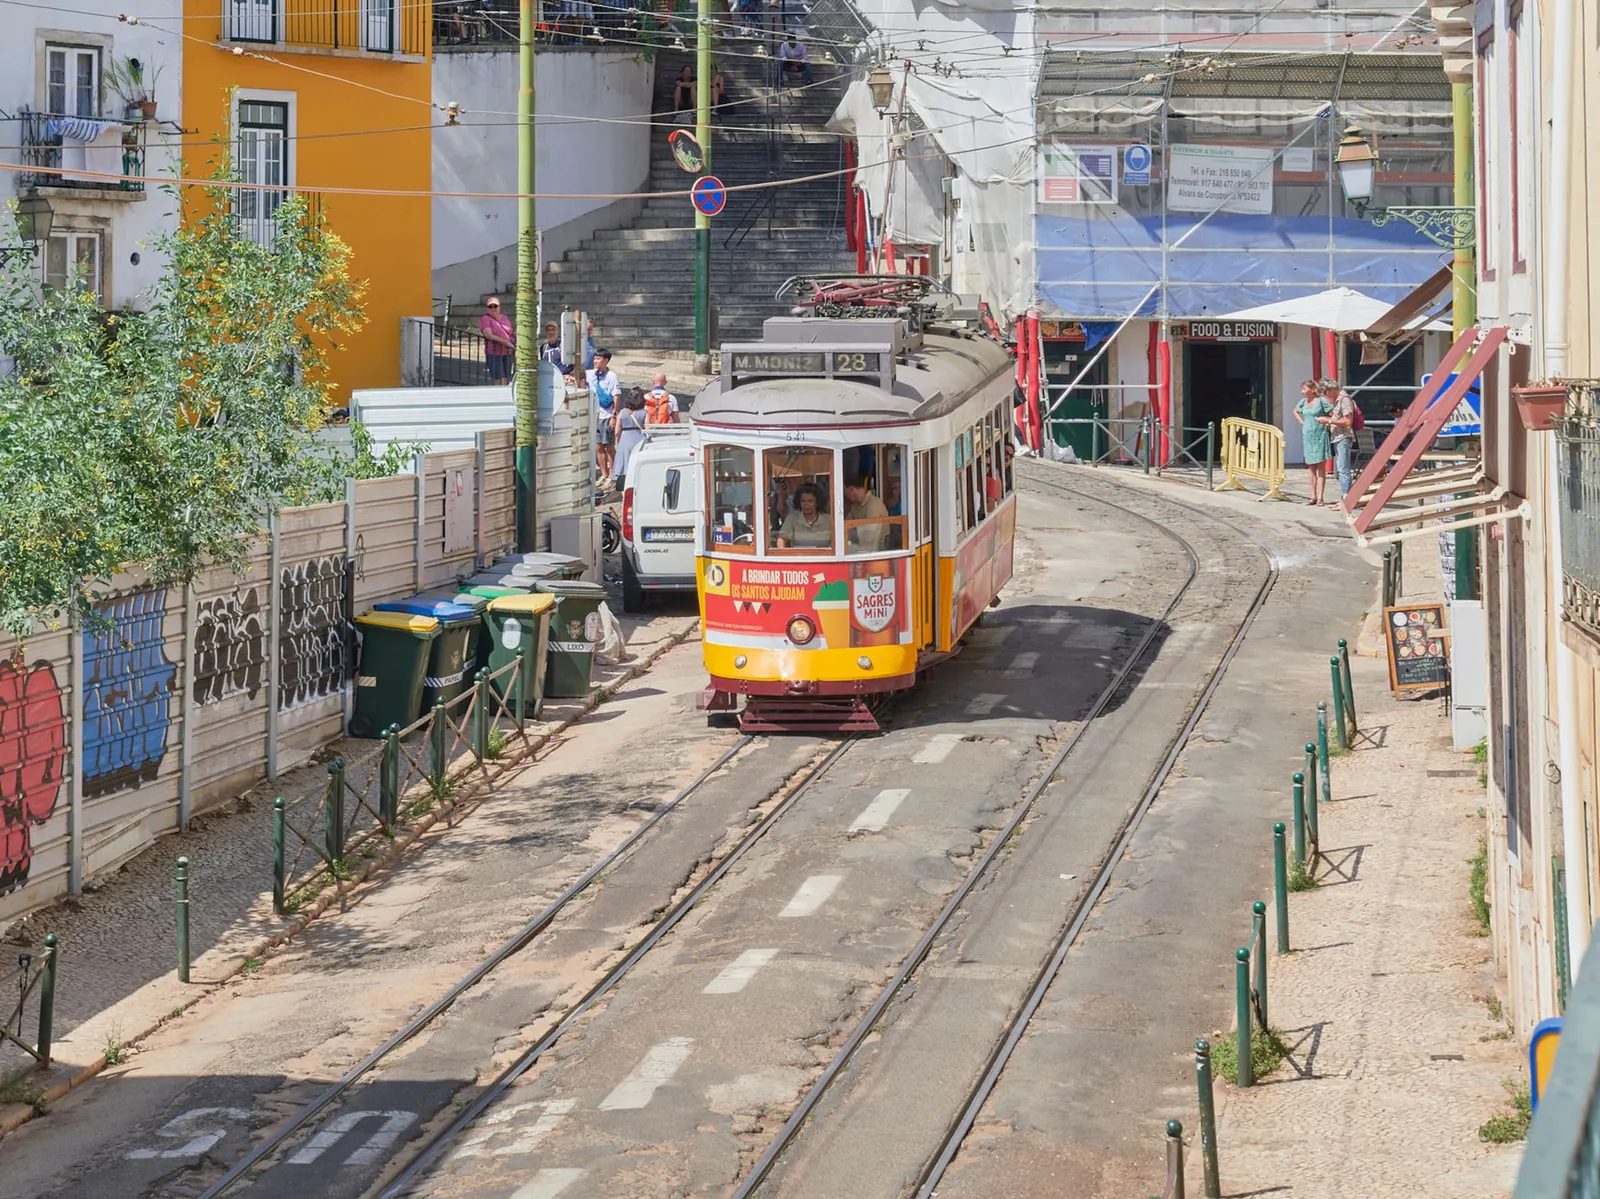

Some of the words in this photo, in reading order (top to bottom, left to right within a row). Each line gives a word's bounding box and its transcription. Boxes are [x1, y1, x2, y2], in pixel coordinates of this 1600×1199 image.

[1197, 189, 1204, 198] de
[1192, 323, 1220, 337] FOOD
[1223, 323, 1232, 337] &
[1235, 323, 1274, 337] FUSION
[735, 355, 752, 368] M.
[755, 355, 814, 370] MONIZ
[837, 353, 867, 372] 28
[785, 432, 806, 442] 541
[742, 569, 748, 583] A
[748, 569, 780, 585] BRINDAR
[782, 571, 809, 585] TODOS
[731, 584, 741, 598] OS
[741, 585, 770, 600] SANTOS
[770, 586, 805, 601] AJUDAM
[857, 592, 894, 609] SAGRES
[567, 643, 585, 651] LIXO
[444, 675, 461, 684] PAPEL
